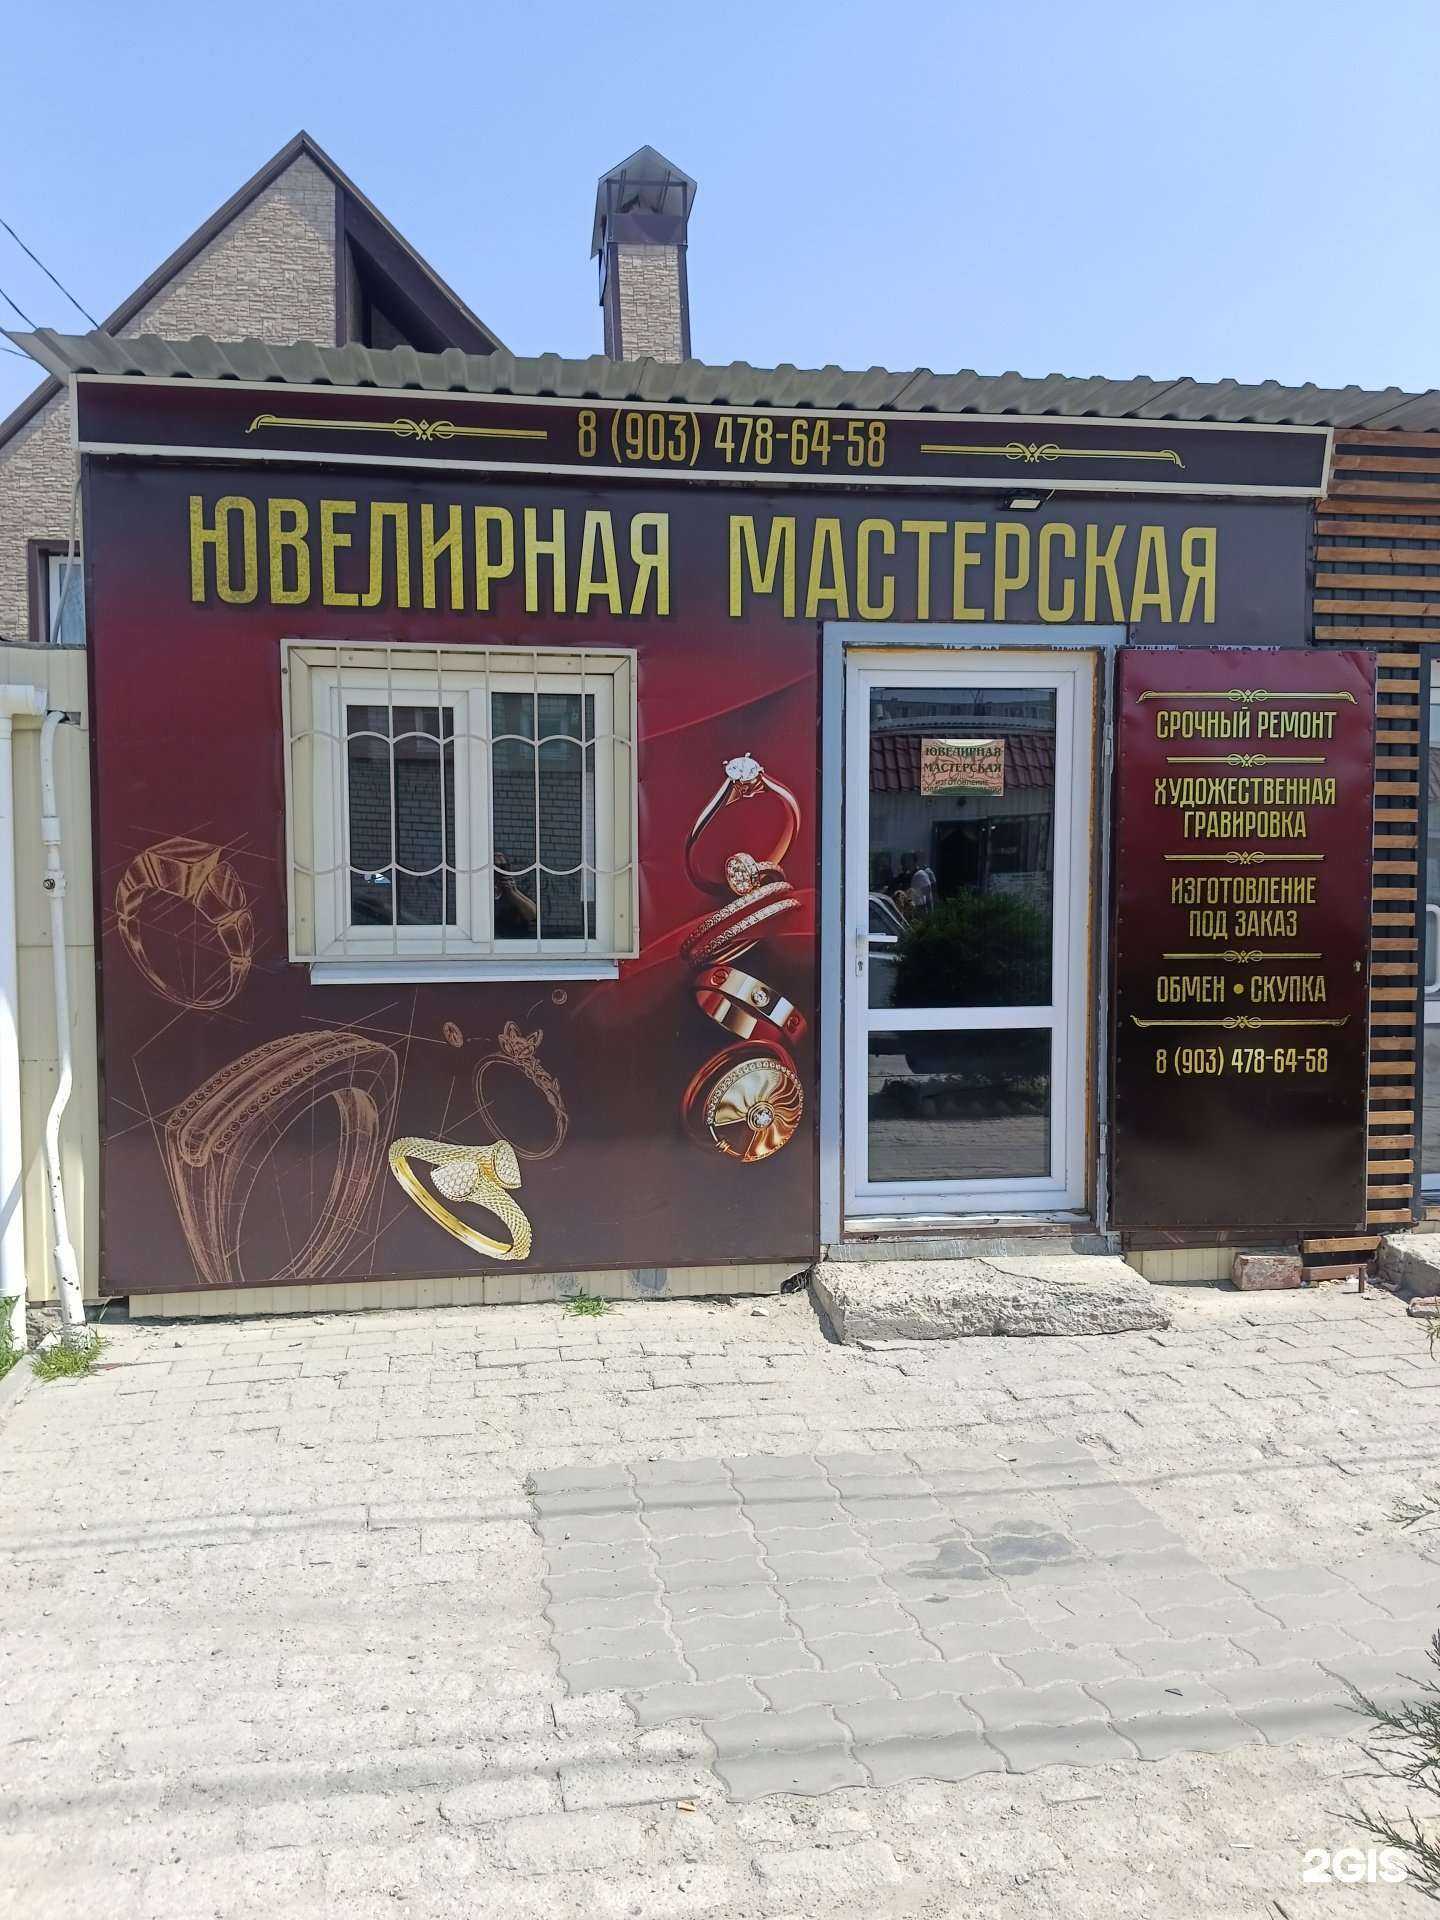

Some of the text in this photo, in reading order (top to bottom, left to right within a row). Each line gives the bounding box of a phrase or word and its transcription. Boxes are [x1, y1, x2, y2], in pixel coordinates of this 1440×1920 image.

[578, 408, 886, 468] 8 (903) 478-64-58
[189, 495, 1217, 624] ЮВЕЛИРНАЯ МАСТЕРСКАЯ
[1156, 706, 1337, 739] СРОЧНЫЙ РЕМОНТ
[925, 747, 1001, 757] ЮВЕЛИРНАЯ
[924, 763, 1002, 773] МАСТЕРСКАЯ
[1154, 777, 1336, 808] ХУДОЖЕСТВЕННАЯ
[1183, 811, 1307, 838] ГРАВИРОВКА
[1171, 877, 1317, 904] ИЗГОТОВЛЕНИЕ
[1189, 910, 1298, 940] ПОД ЗАКАЗ
[1157, 975, 1326, 1003] ОБМЕН СКУПКА
[1156, 1046, 1328, 1076] 8 (903) 478-64-58
